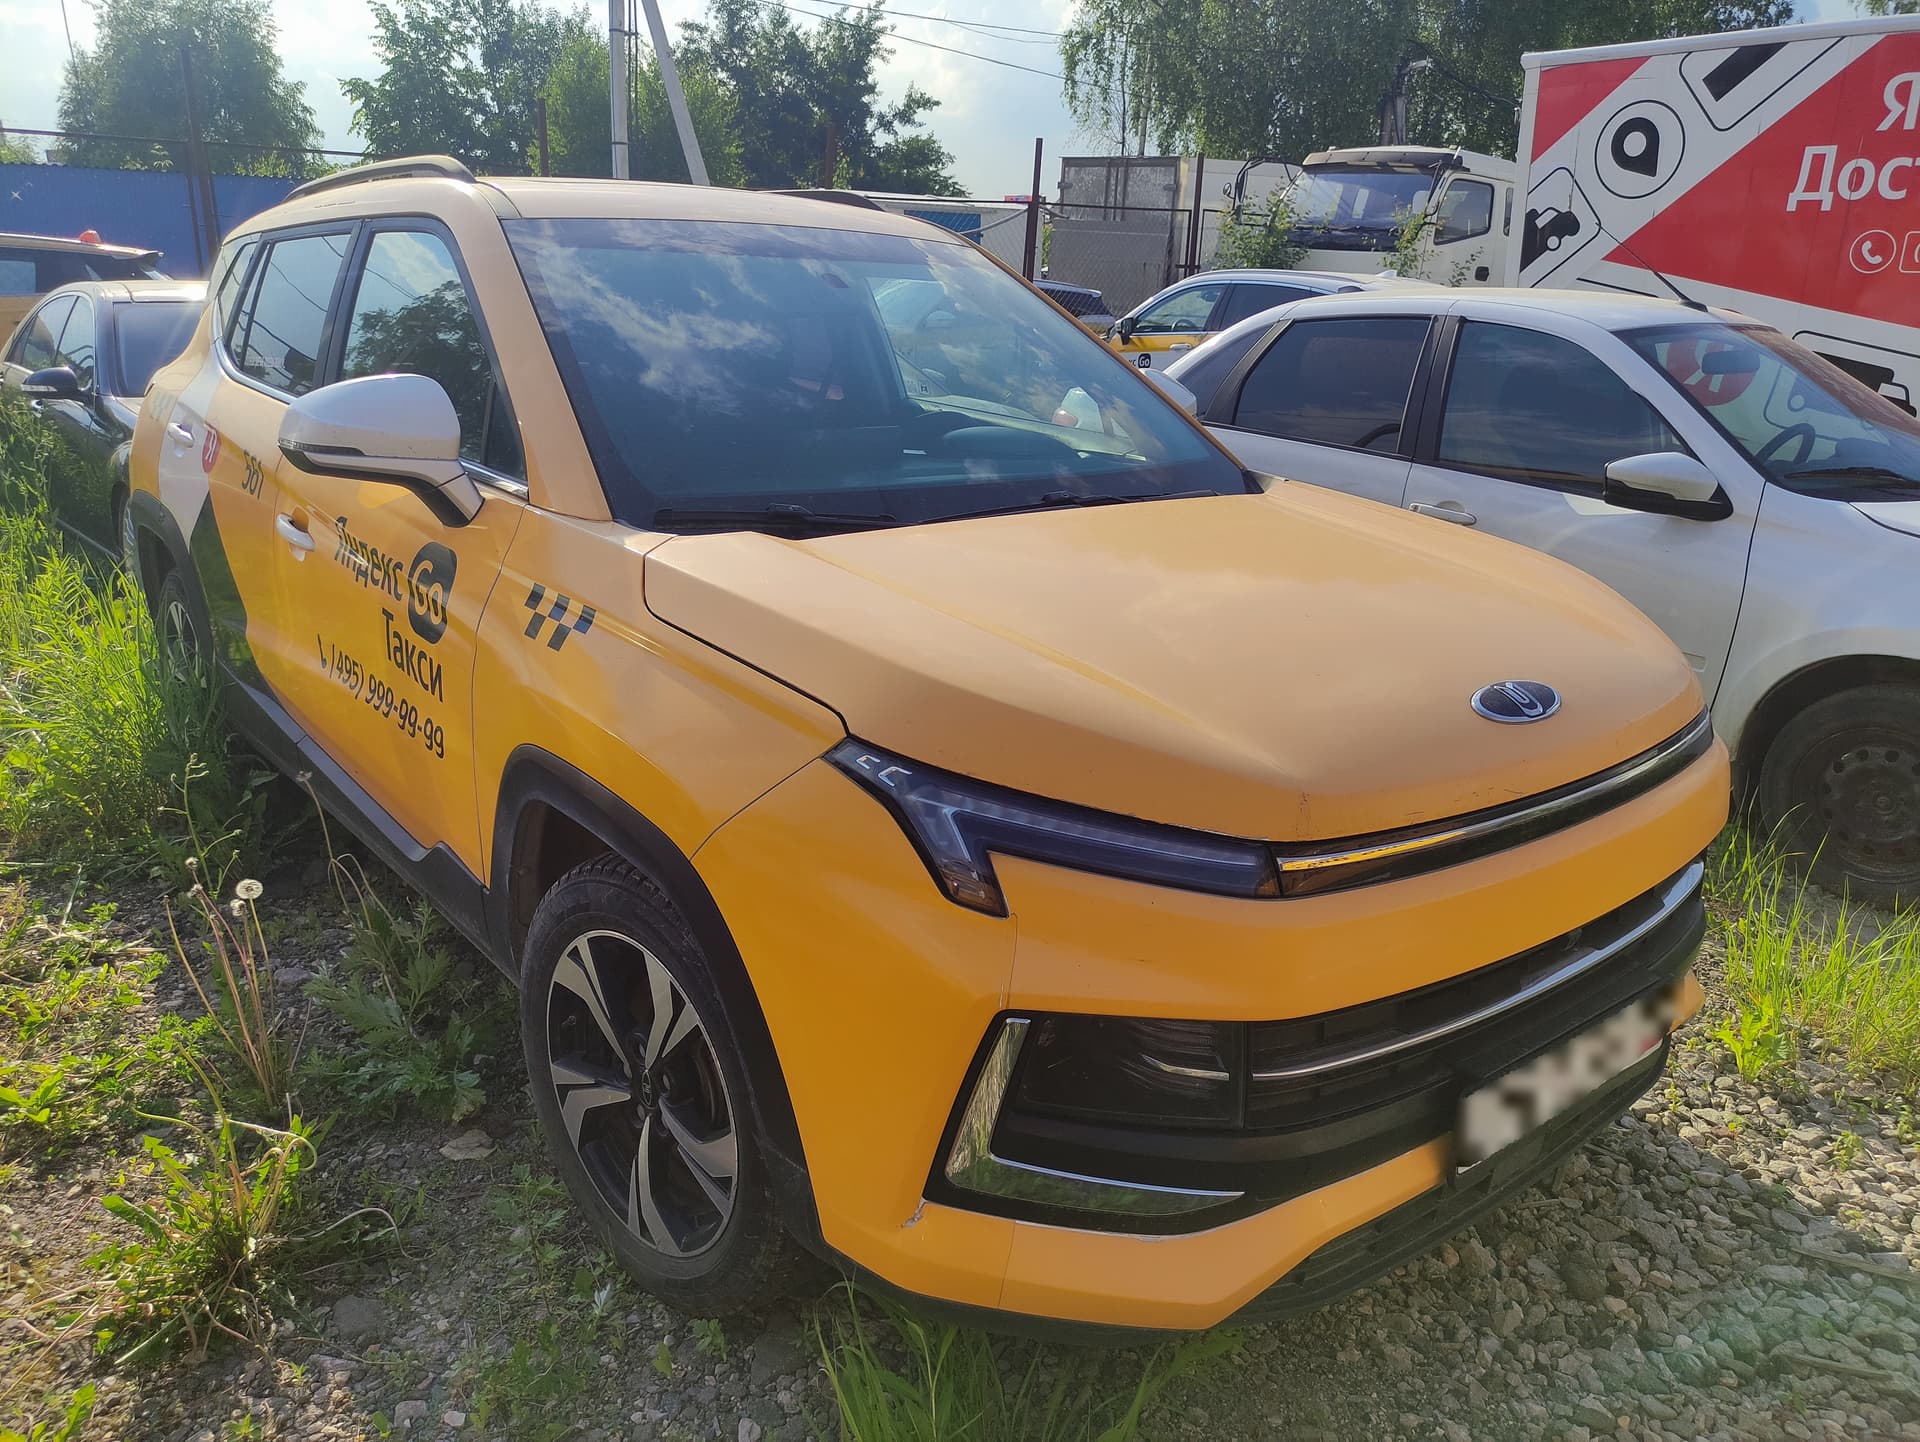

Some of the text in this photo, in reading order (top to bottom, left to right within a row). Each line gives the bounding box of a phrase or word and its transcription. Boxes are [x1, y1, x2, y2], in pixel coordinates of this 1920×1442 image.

[1786, 144, 1920, 212] Дос
[242, 449, 264, 501] 561
[334, 515, 444, 625] Яндекс Go
[330, 644, 445, 759] (495) 999-99-99
[382, 607, 444, 703] Такси
